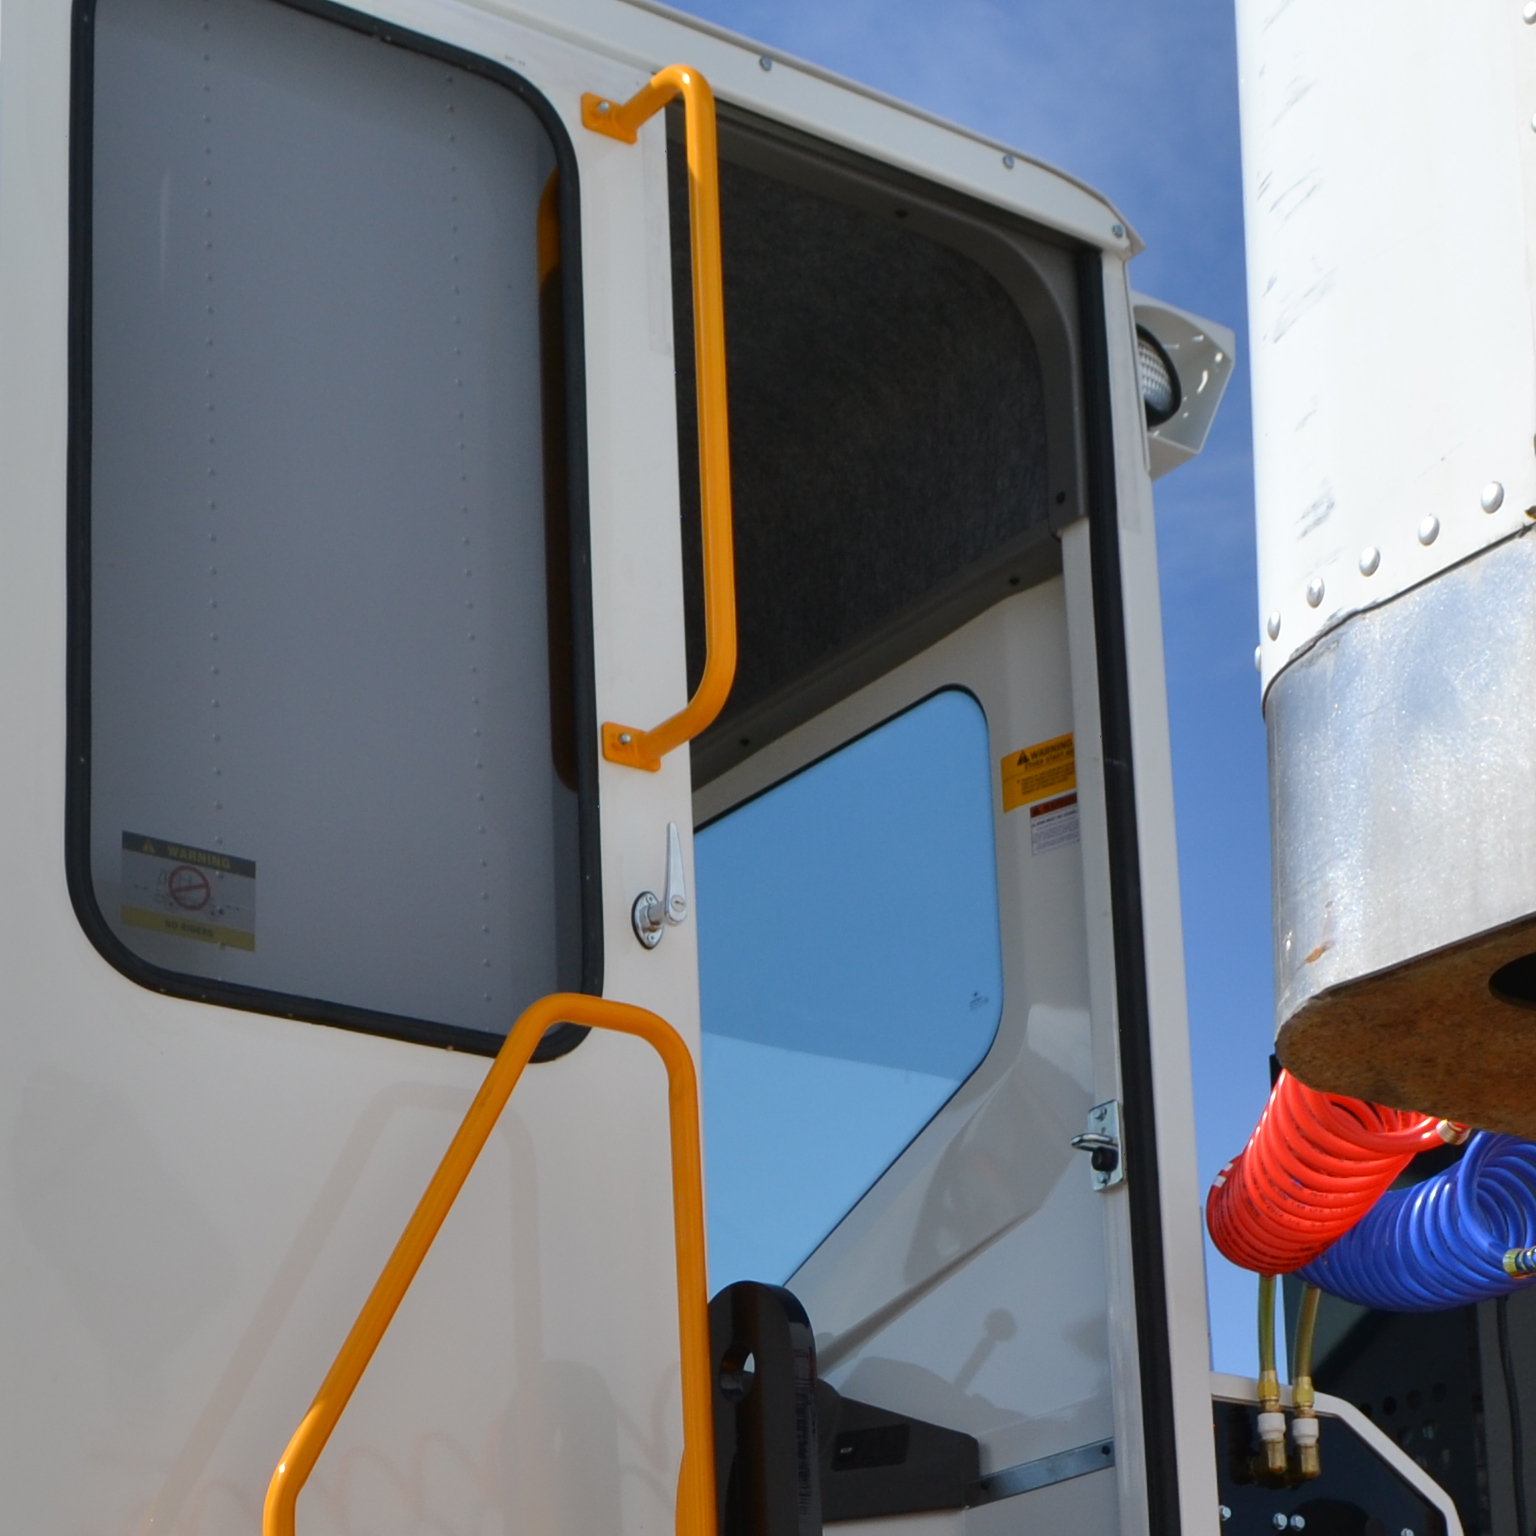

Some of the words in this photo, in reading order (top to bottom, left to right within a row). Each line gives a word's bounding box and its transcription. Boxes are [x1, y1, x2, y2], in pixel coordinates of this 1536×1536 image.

[167, 844, 231, 869] WARNING
[165, 919, 178, 930] NO
[180, 924, 214, 937] RIDERS
